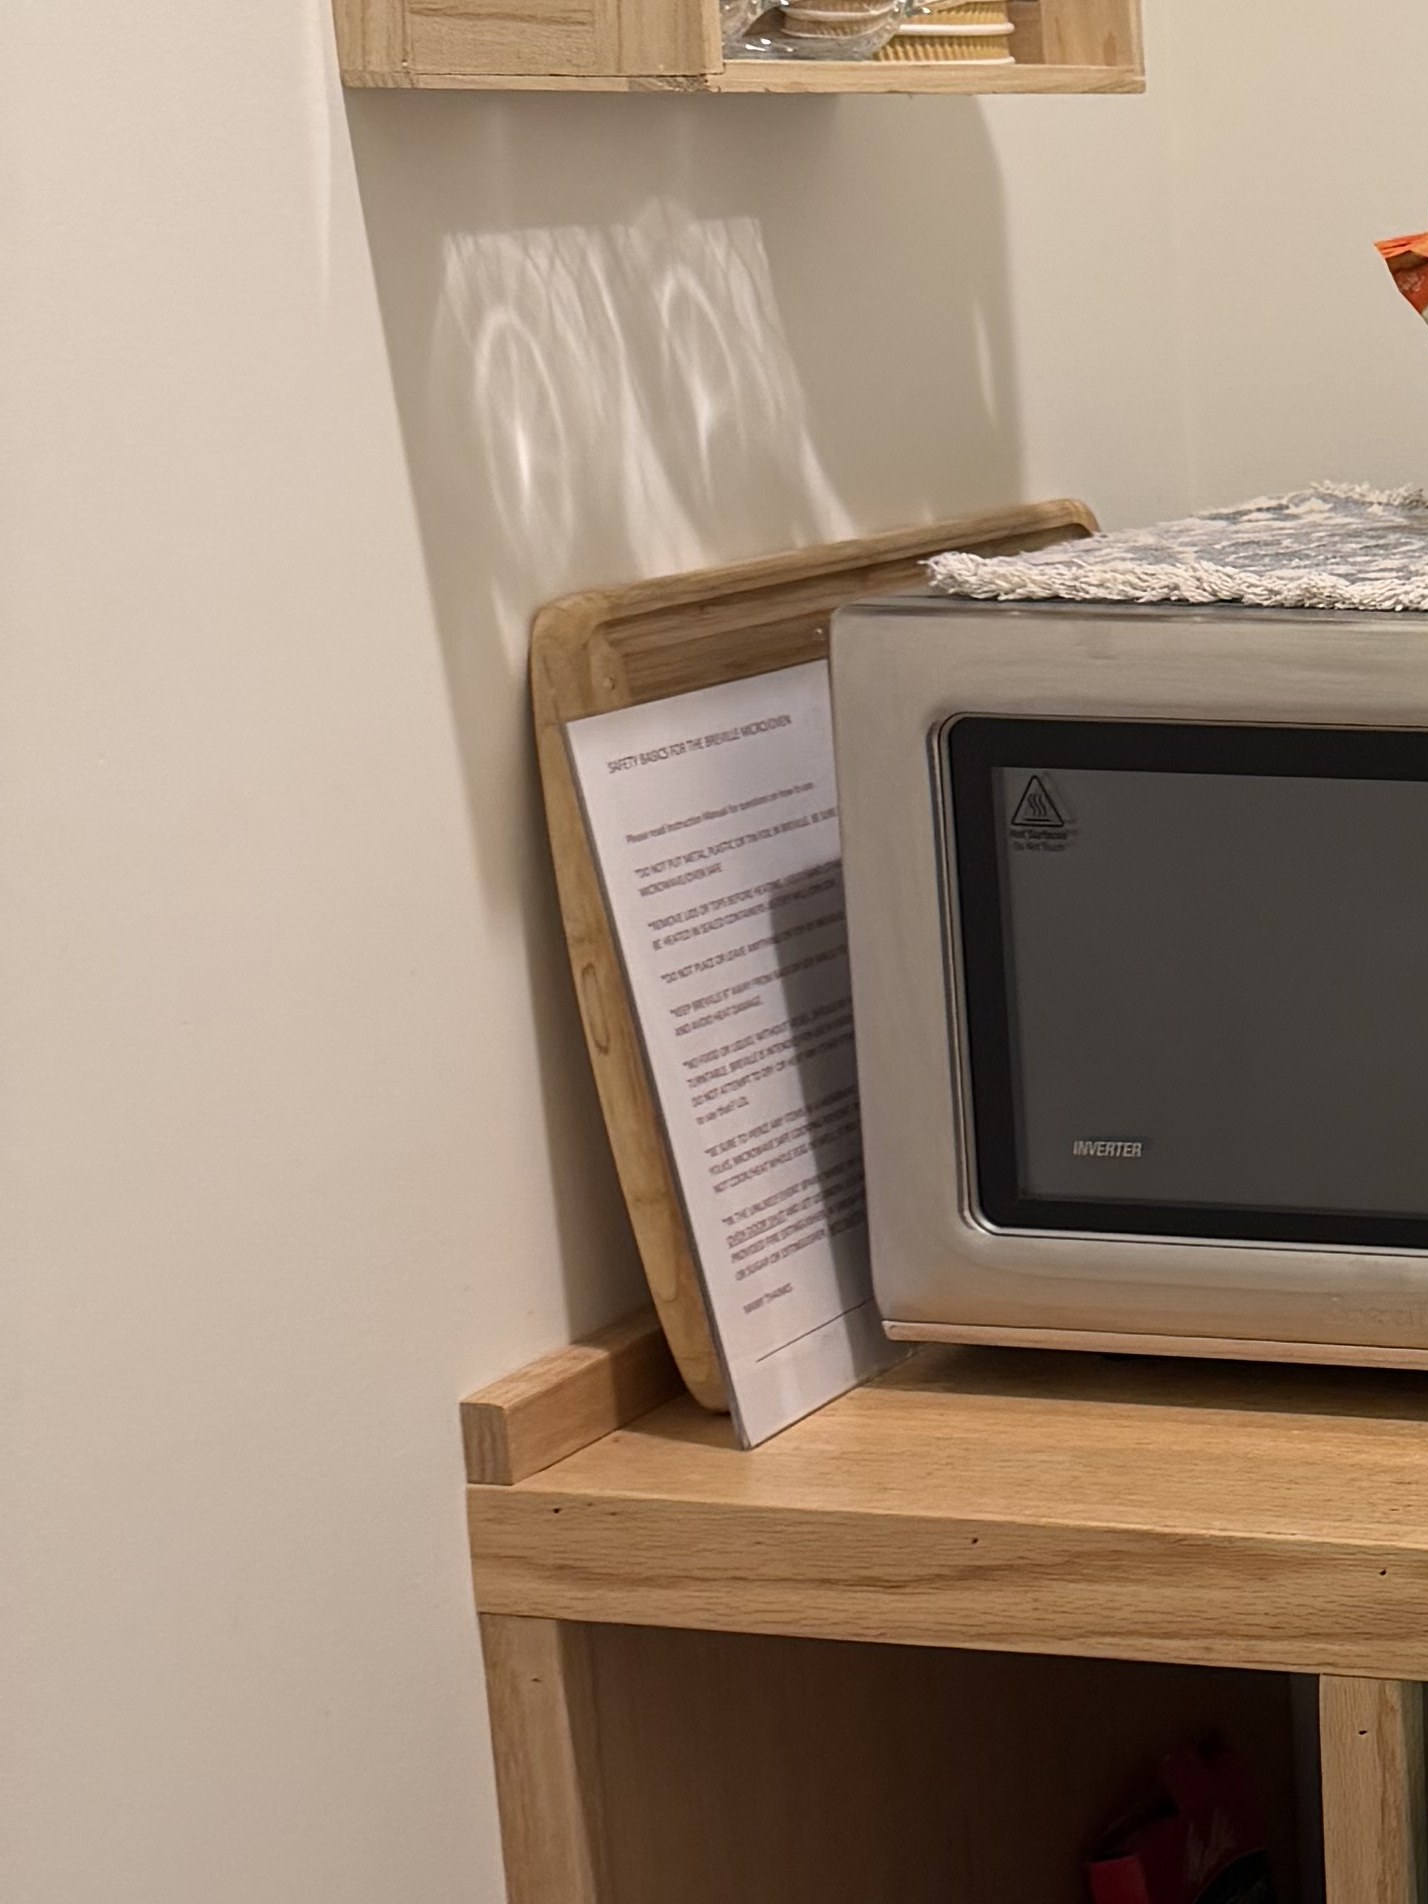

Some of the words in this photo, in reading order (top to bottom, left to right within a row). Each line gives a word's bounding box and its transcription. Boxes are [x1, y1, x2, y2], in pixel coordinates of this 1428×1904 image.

[607, 757, 638, 774] SAFETY
[640, 748, 668, 765] BASICS
[670, 744, 685, 757] FOR
[687, 739, 703, 752] THE
[1073, 1140, 1142, 1157] INVERTER
